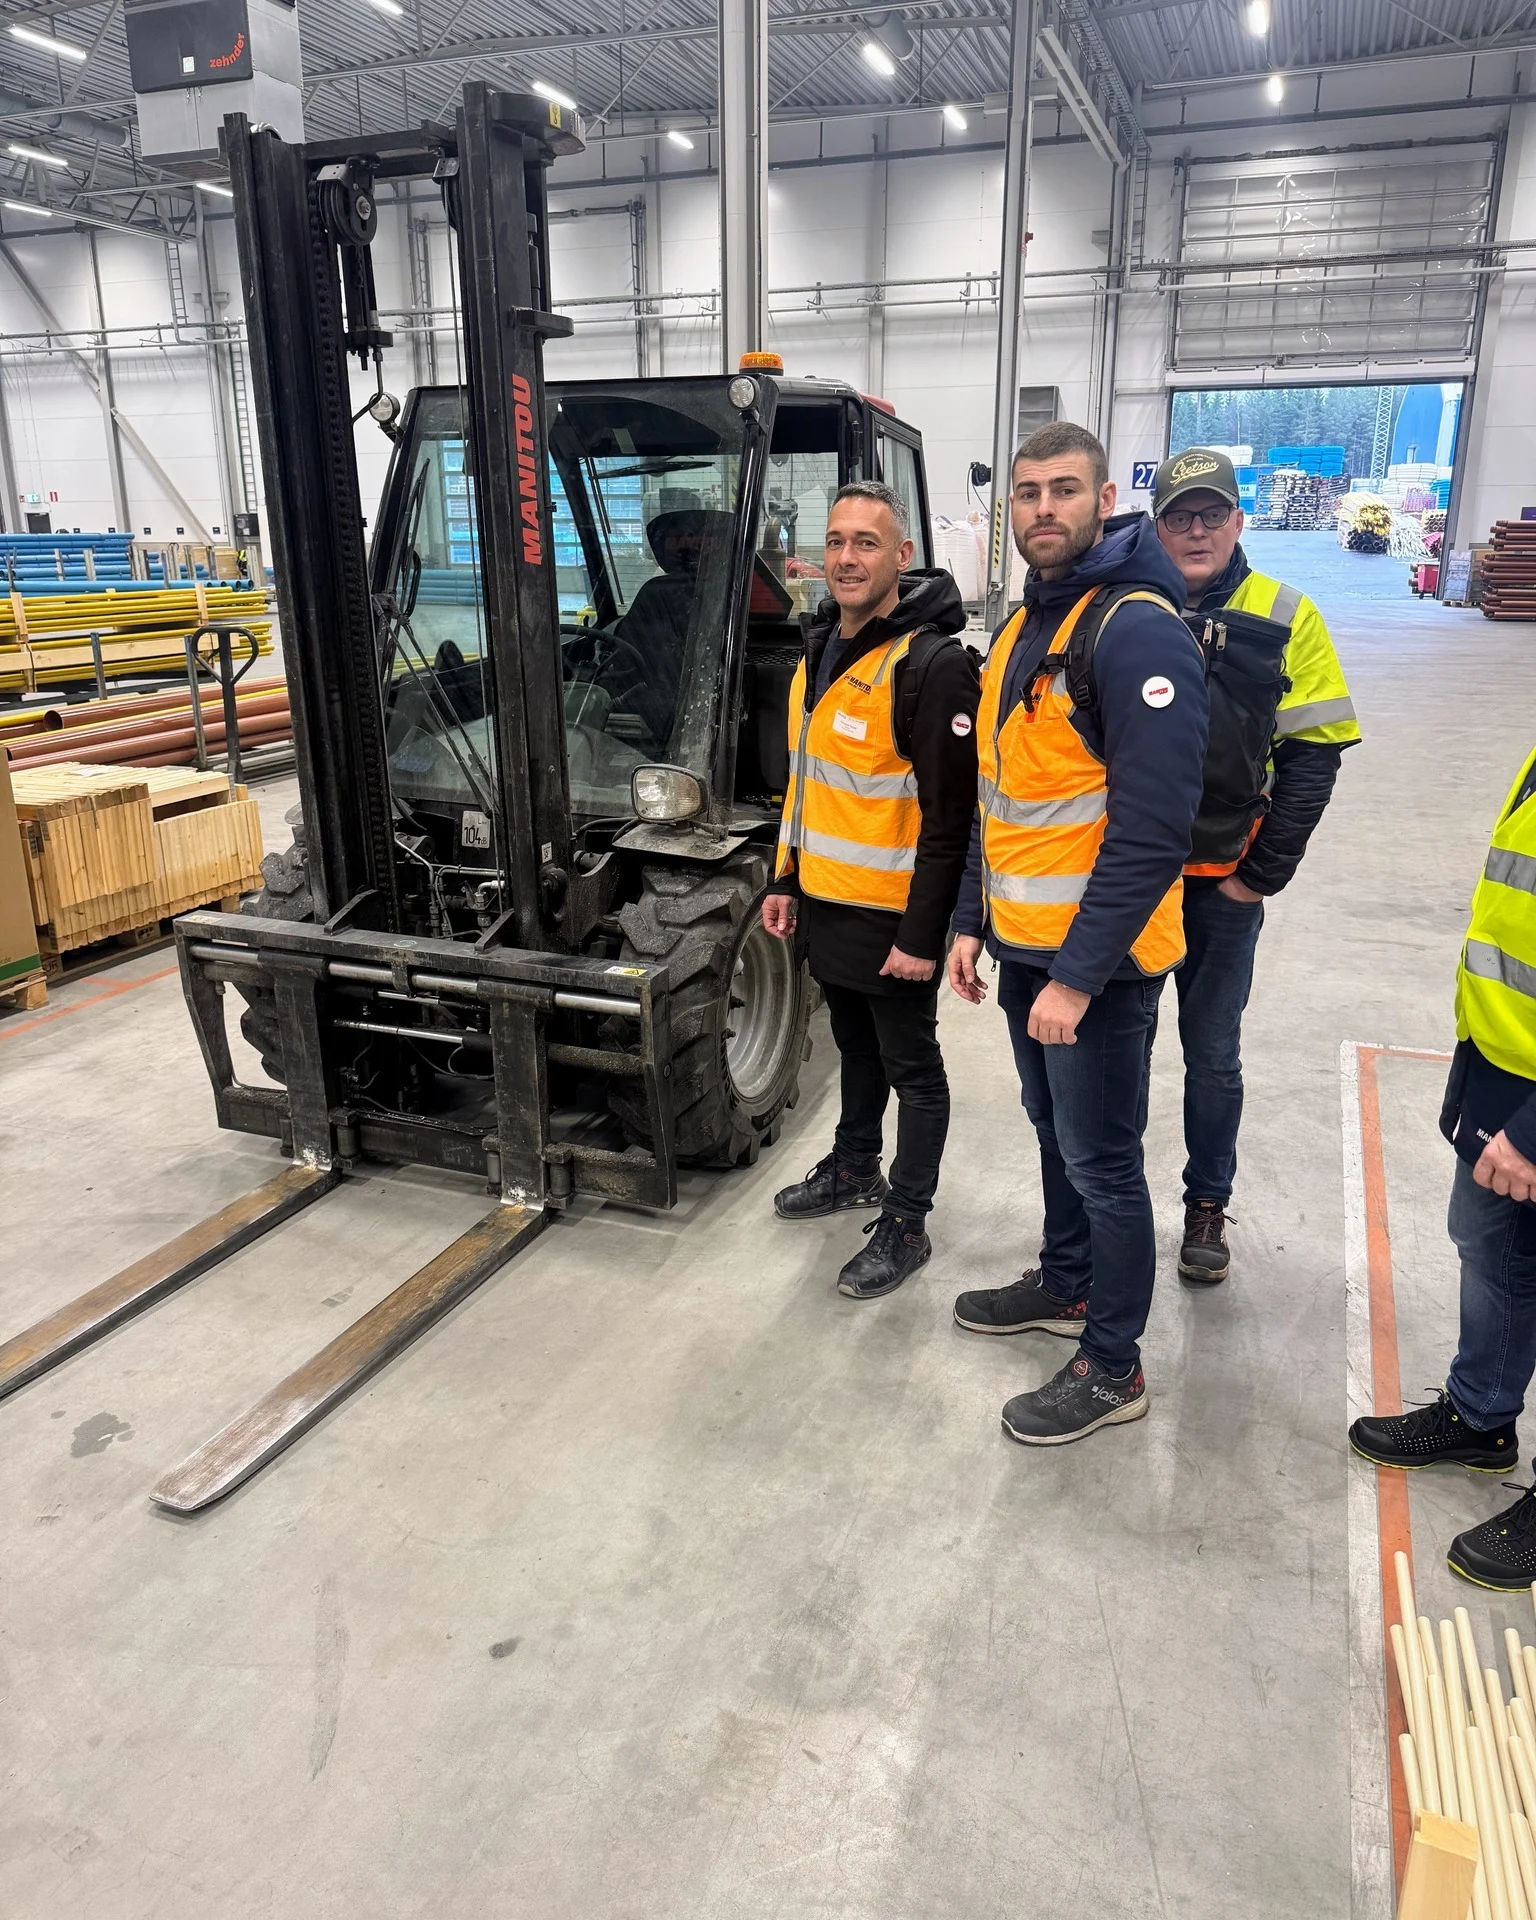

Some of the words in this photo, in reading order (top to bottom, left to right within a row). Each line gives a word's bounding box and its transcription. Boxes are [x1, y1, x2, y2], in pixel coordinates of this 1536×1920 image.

[209, 33, 245, 68] zehnder
[512, 373, 542, 566] MANITOU
[1134, 463, 1158, 488] 27
[1169, 461, 1219, 484] Stetson
[464, 825, 481, 844] 104
[1092, 1386, 1125, 1406] jalas
